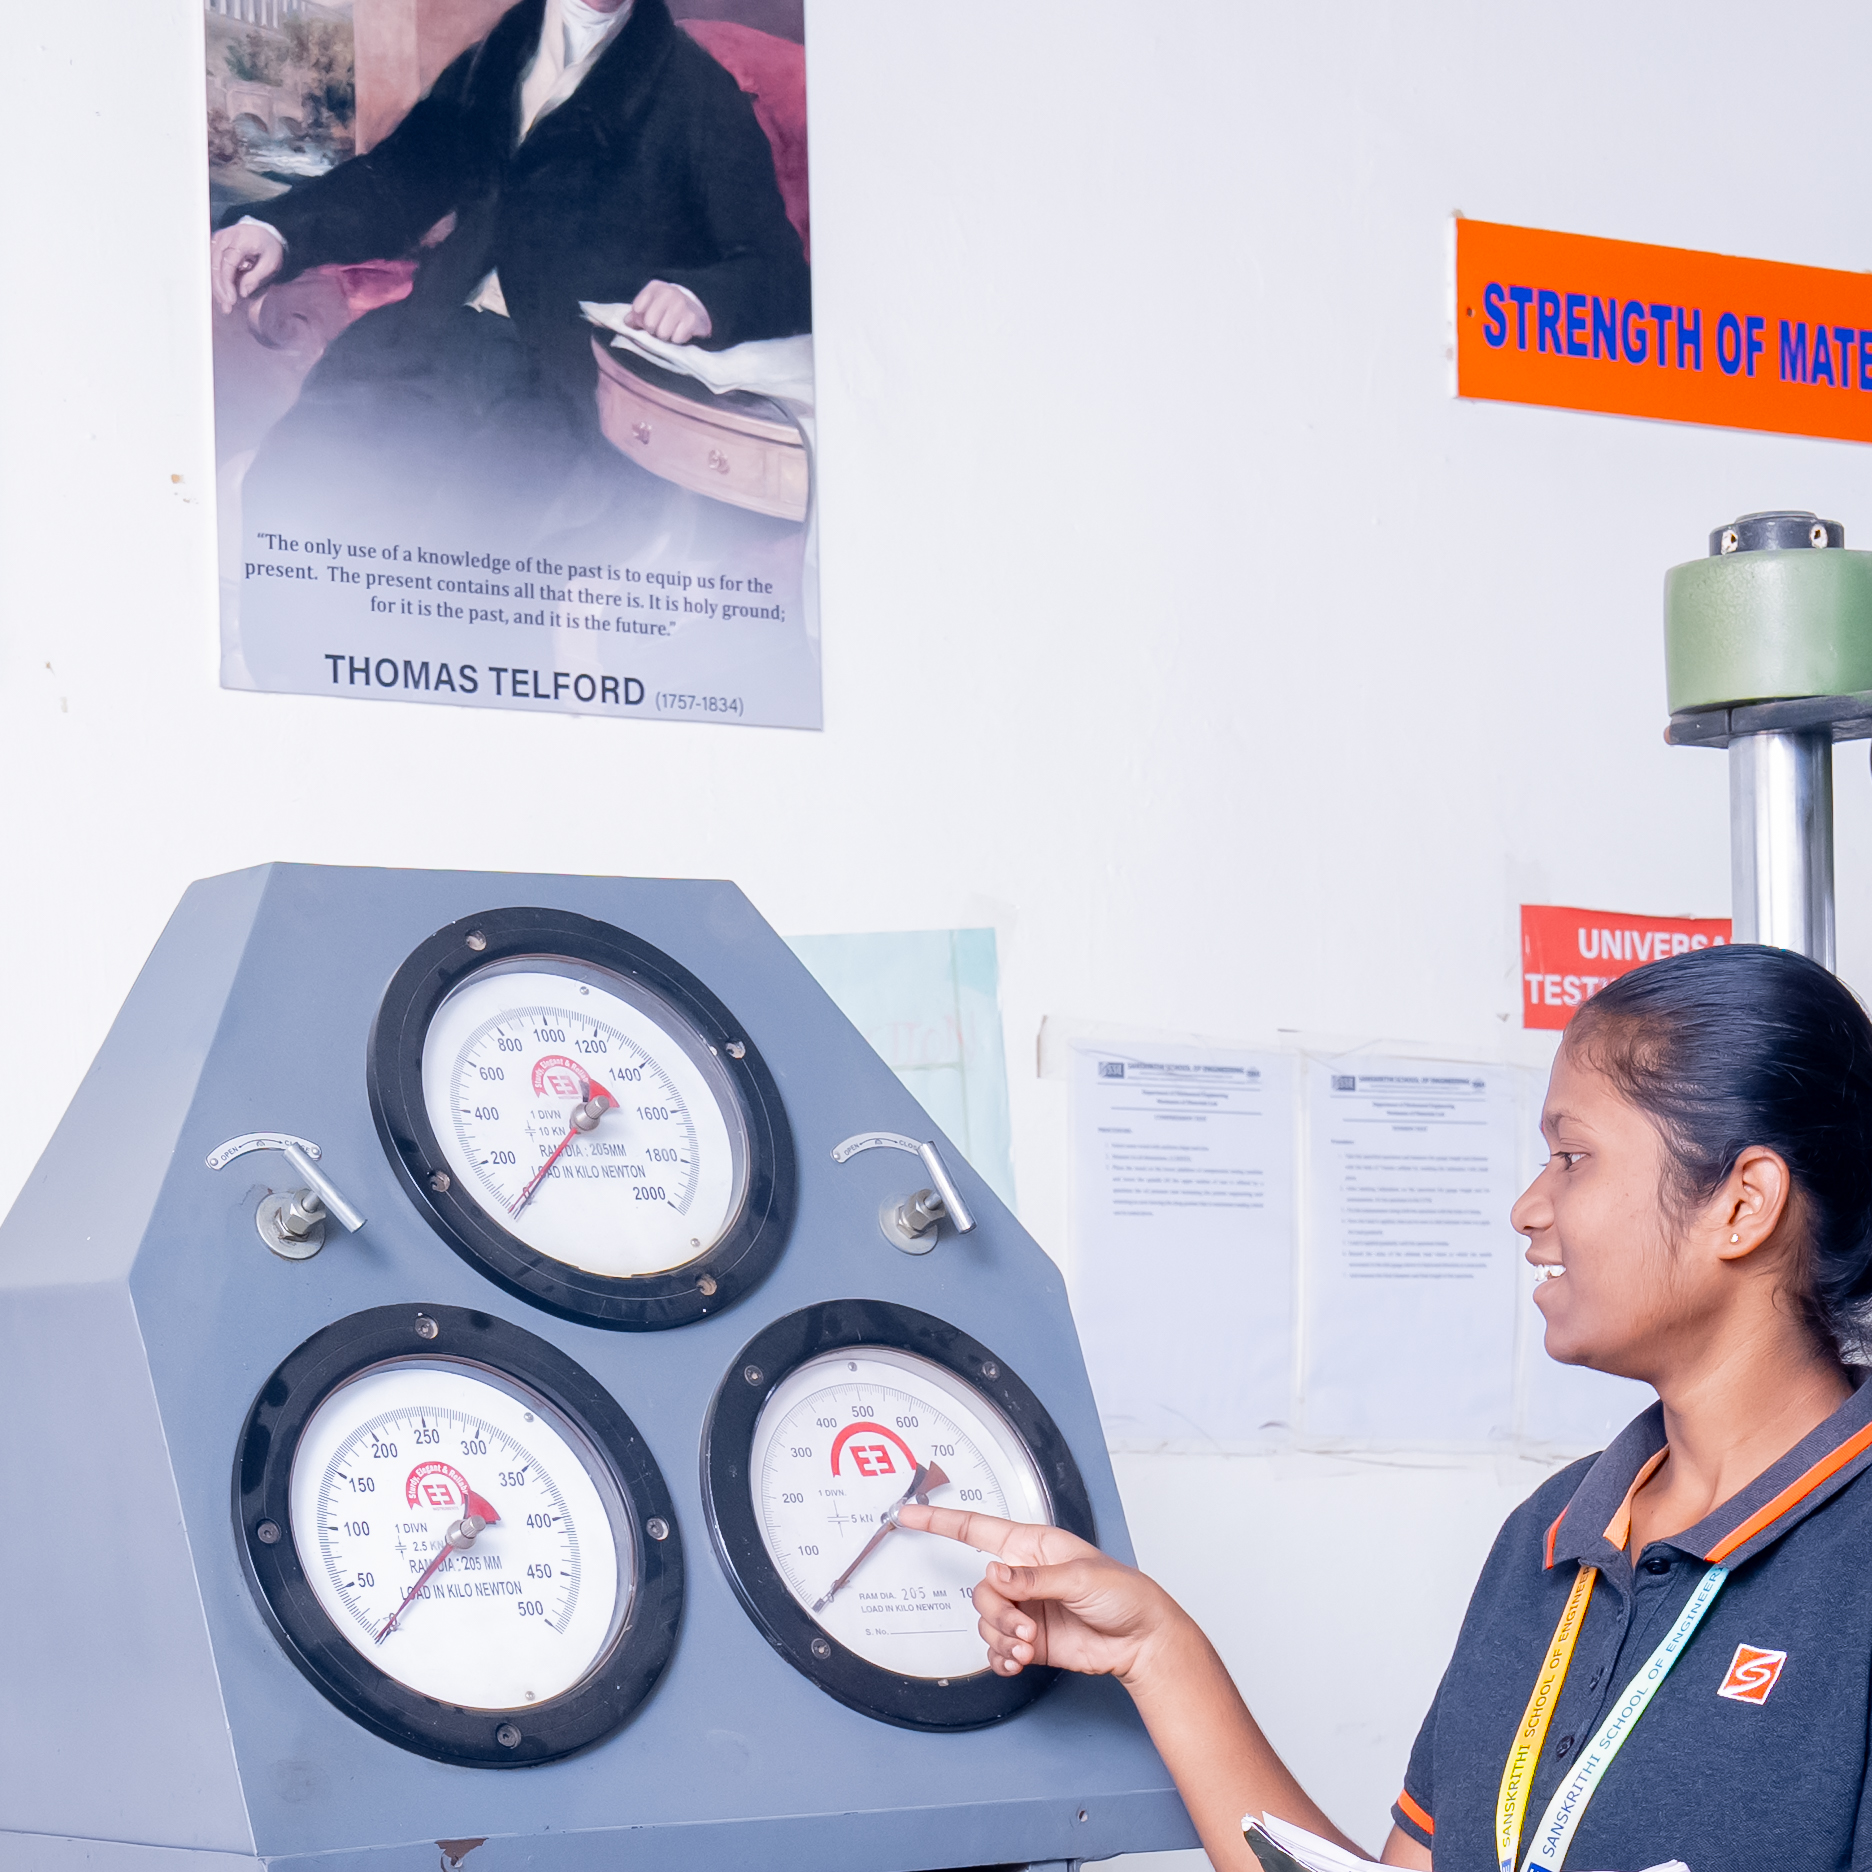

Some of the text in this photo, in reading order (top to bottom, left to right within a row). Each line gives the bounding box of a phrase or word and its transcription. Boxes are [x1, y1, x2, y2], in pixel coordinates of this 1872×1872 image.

[1484, 282, 1701, 370] STRENGTH
[1717, 312, 1764, 378] OF
[370, 595, 397, 614] for
[400, 598, 414, 615] it
[417, 599, 433, 617] is
[436, 600, 464, 620] the
[468, 607, 510, 626] past,
[512, 609, 545, 627] and
[549, 610, 562, 628] it
[566, 612, 580, 630] is
[584, 614, 612, 632] the
[324, 652, 745, 717] THOMAS TELFORD (1757-1834)
[533, 1029, 565, 1042] 1000
[498, 1038, 523, 1052] 800
[574, 1039, 607, 1054] 1200
[480, 1066, 504, 1081] 600
[609, 1067, 641, 1081] 1400
[474, 1106, 499, 1120] 400
[636, 1106, 669, 1120] 1600
[490, 1150, 516, 1165] 200
[645, 1148, 678, 1162] 1800
[576, 1165, 645, 1178] KILO NEWTON
[633, 1186, 666, 1201] 2000
[851, 1405, 874, 1418] 500
[815, 1417, 837, 1429] 400
[896, 1416, 919, 1428] 600
[414, 1430, 440, 1444] 250
[371, 1443, 398, 1458] 200
[461, 1440, 487, 1455] 300
[791, 1446, 812, 1458] 300
[931, 1444, 954, 1457] 700
[349, 1478, 375, 1493] 150
[499, 1471, 524, 1487] 350
[782, 1492, 804, 1504] 200
[960, 1488, 982, 1501] 800
[527, 1513, 551, 1529] 400
[344, 1521, 370, 1537] 100
[797, 1545, 819, 1557] 100
[527, 1564, 552, 1578] 450
[357, 1573, 375, 1587] 50
[448, 1582, 522, 1597] KILO NEWTON
[518, 1601, 543, 1616] 500
[861, 1602, 950, 1613] LOAD IN KILO NEWTON
[1502, 1649, 1562, 1847] SANSKRITHI SCHOOL OF
[1543, 1658, 1663, 1857] SANSKRITHI SCHOOL OF
